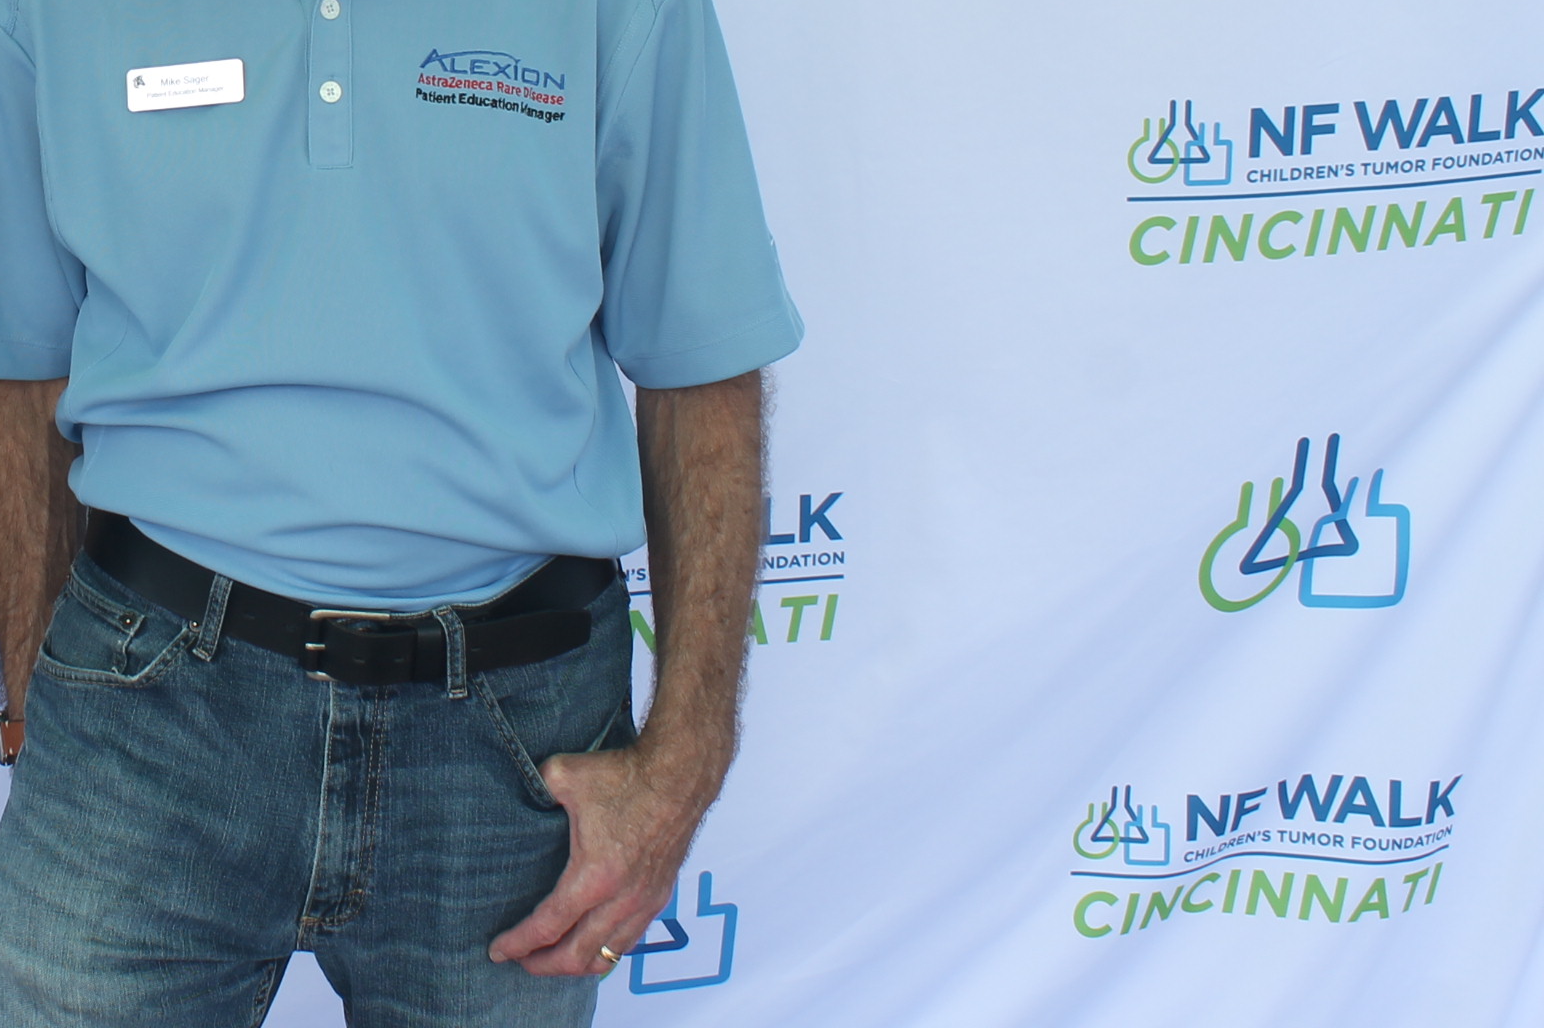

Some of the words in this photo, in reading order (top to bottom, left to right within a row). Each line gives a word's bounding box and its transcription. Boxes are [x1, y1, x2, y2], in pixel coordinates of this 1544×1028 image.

[160, 77, 181, 87] Mike
[417, 73, 493, 91] AstraZeneca
[496, 81, 522, 96] Rare
[523, 86, 564, 105] Disease
[419, 48, 565, 90] ALEXION
[415, 88, 457, 104] Patient
[458, 93, 519, 112] Education
[1248, 102, 1340, 158] NF
[1353, 87, 1544, 151] WALK
[1246, 162, 1355, 184] CHILDREN'S
[1361, 158, 1426, 176] TUMOR
[1431, 146, 1544, 171] FOUNDATION
[1128, 188, 1535, 266] CINCINNATI
[1186, 787, 1267, 841] NF
[1277, 774, 1463, 828] WALK
[1183, 829, 1271, 863] CHILDREN'S
[1277, 830, 1344, 848] TUMOR
[1351, 824, 1453, 852] FOUNDATION
[1073, 861, 1443, 938] CINCINNATI
